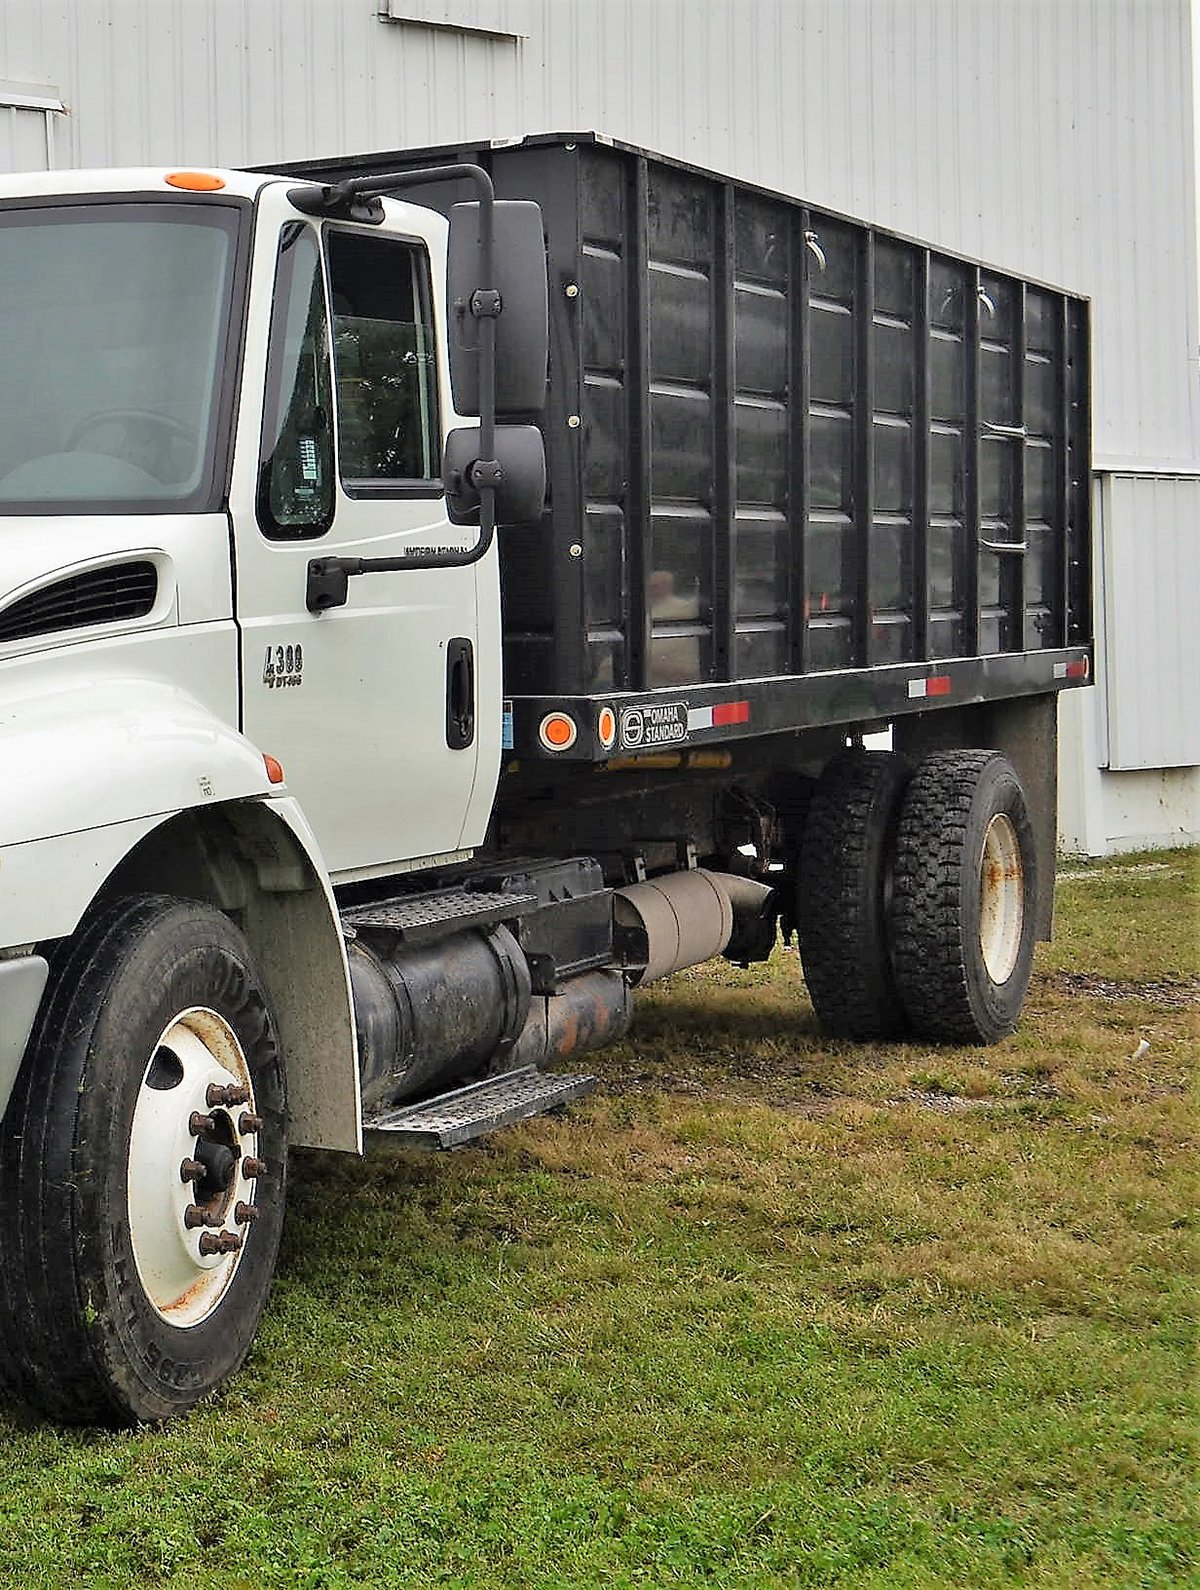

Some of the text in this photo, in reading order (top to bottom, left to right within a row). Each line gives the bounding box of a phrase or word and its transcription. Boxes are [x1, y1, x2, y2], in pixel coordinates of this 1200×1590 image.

[263, 644, 302, 688] 4300
[651, 706, 679, 724] OMAHA
[646, 722, 684, 742] STANDARD
